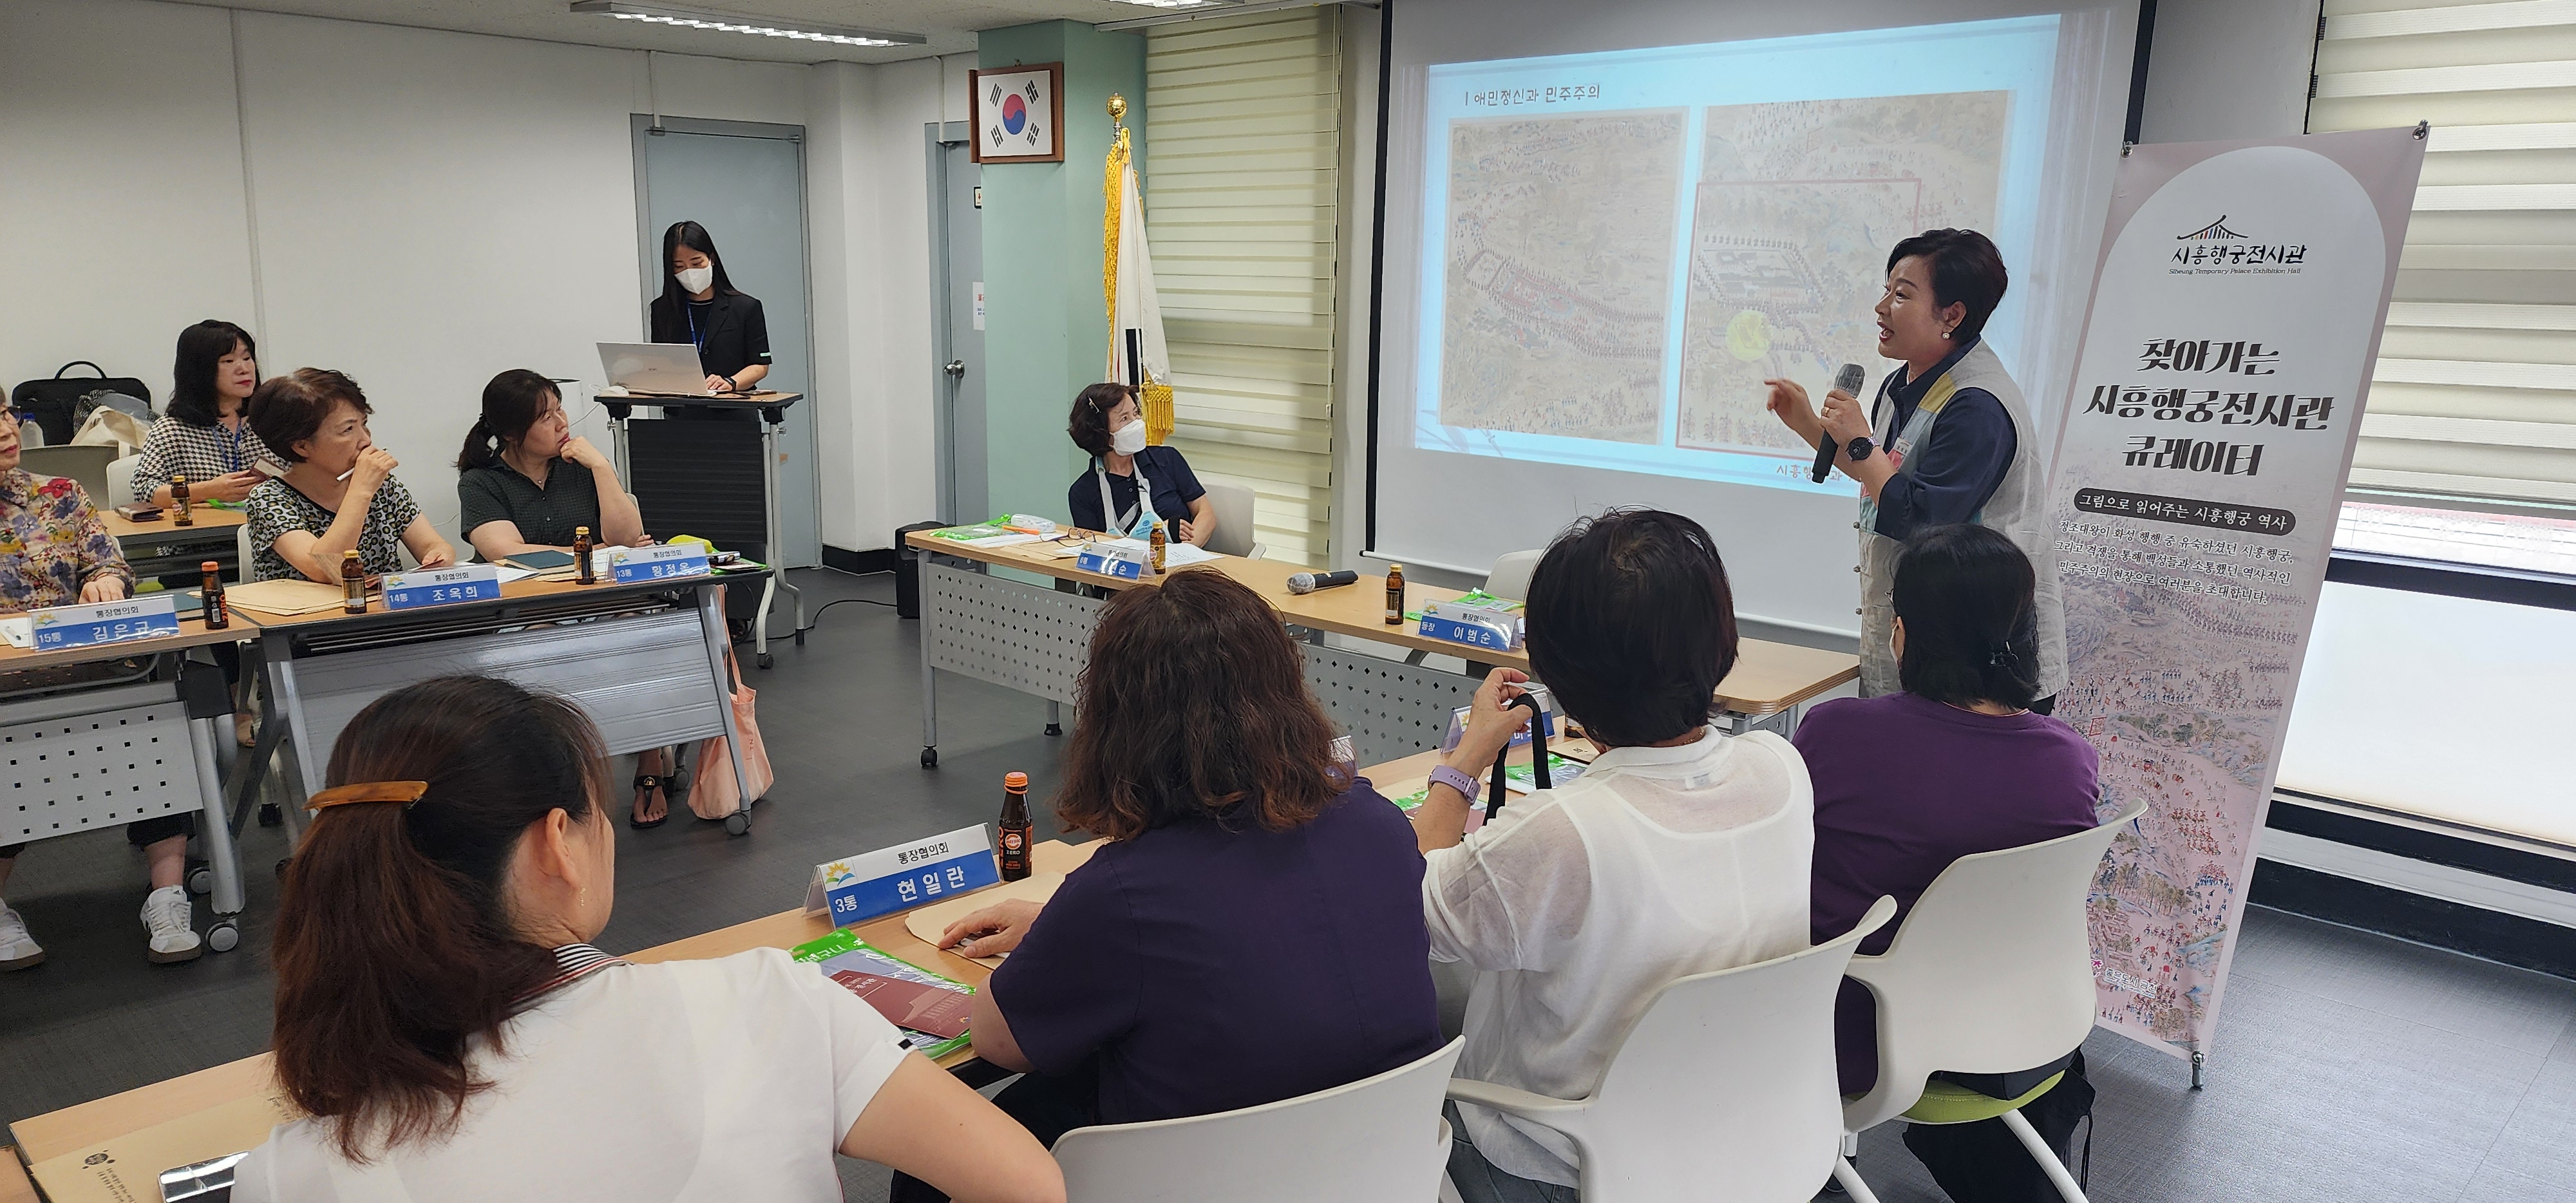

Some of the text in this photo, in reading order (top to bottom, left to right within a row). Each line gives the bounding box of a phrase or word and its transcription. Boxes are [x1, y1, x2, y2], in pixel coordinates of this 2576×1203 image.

[1474, 84, 1600, 106] 애민정신과 민주주의
[2171, 244, 2307, 265] 시흥행궁전시관
[2136, 338, 2280, 375] 찾아가는
[2083, 384, 2334, 430] 시흥행궁전시관
[2121, 435, 2264, 476] 큐레이터
[2079, 495, 2287, 531] 그림으로 읽어주는 시흥행궁 역사
[653, 549, 682, 558] 통장협의회
[2060, 521, 2293, 564] 정조대왕이 화성 행행 중 유숙하셨던 시흥행궁,
[2054, 541, 2291, 585] 그리고 격쟁을 통해 백성들과 소통했던 역사적인
[435, 572, 469, 582] 통장협의회
[2060, 561, 2267, 605] 민주주의의 현장으로 여러분을 초대합니다.
[432, 585, 478, 602] 조옥희
[96, 605, 139, 618] 통장협의회
[39, 632, 62, 644] 15통
[1454, 625, 1491, 645] 이범순
[898, 841, 949, 865] 통장협의회
[835, 866, 965, 913] 3통 현일란
[2140, 980, 2157, 994] 금천
